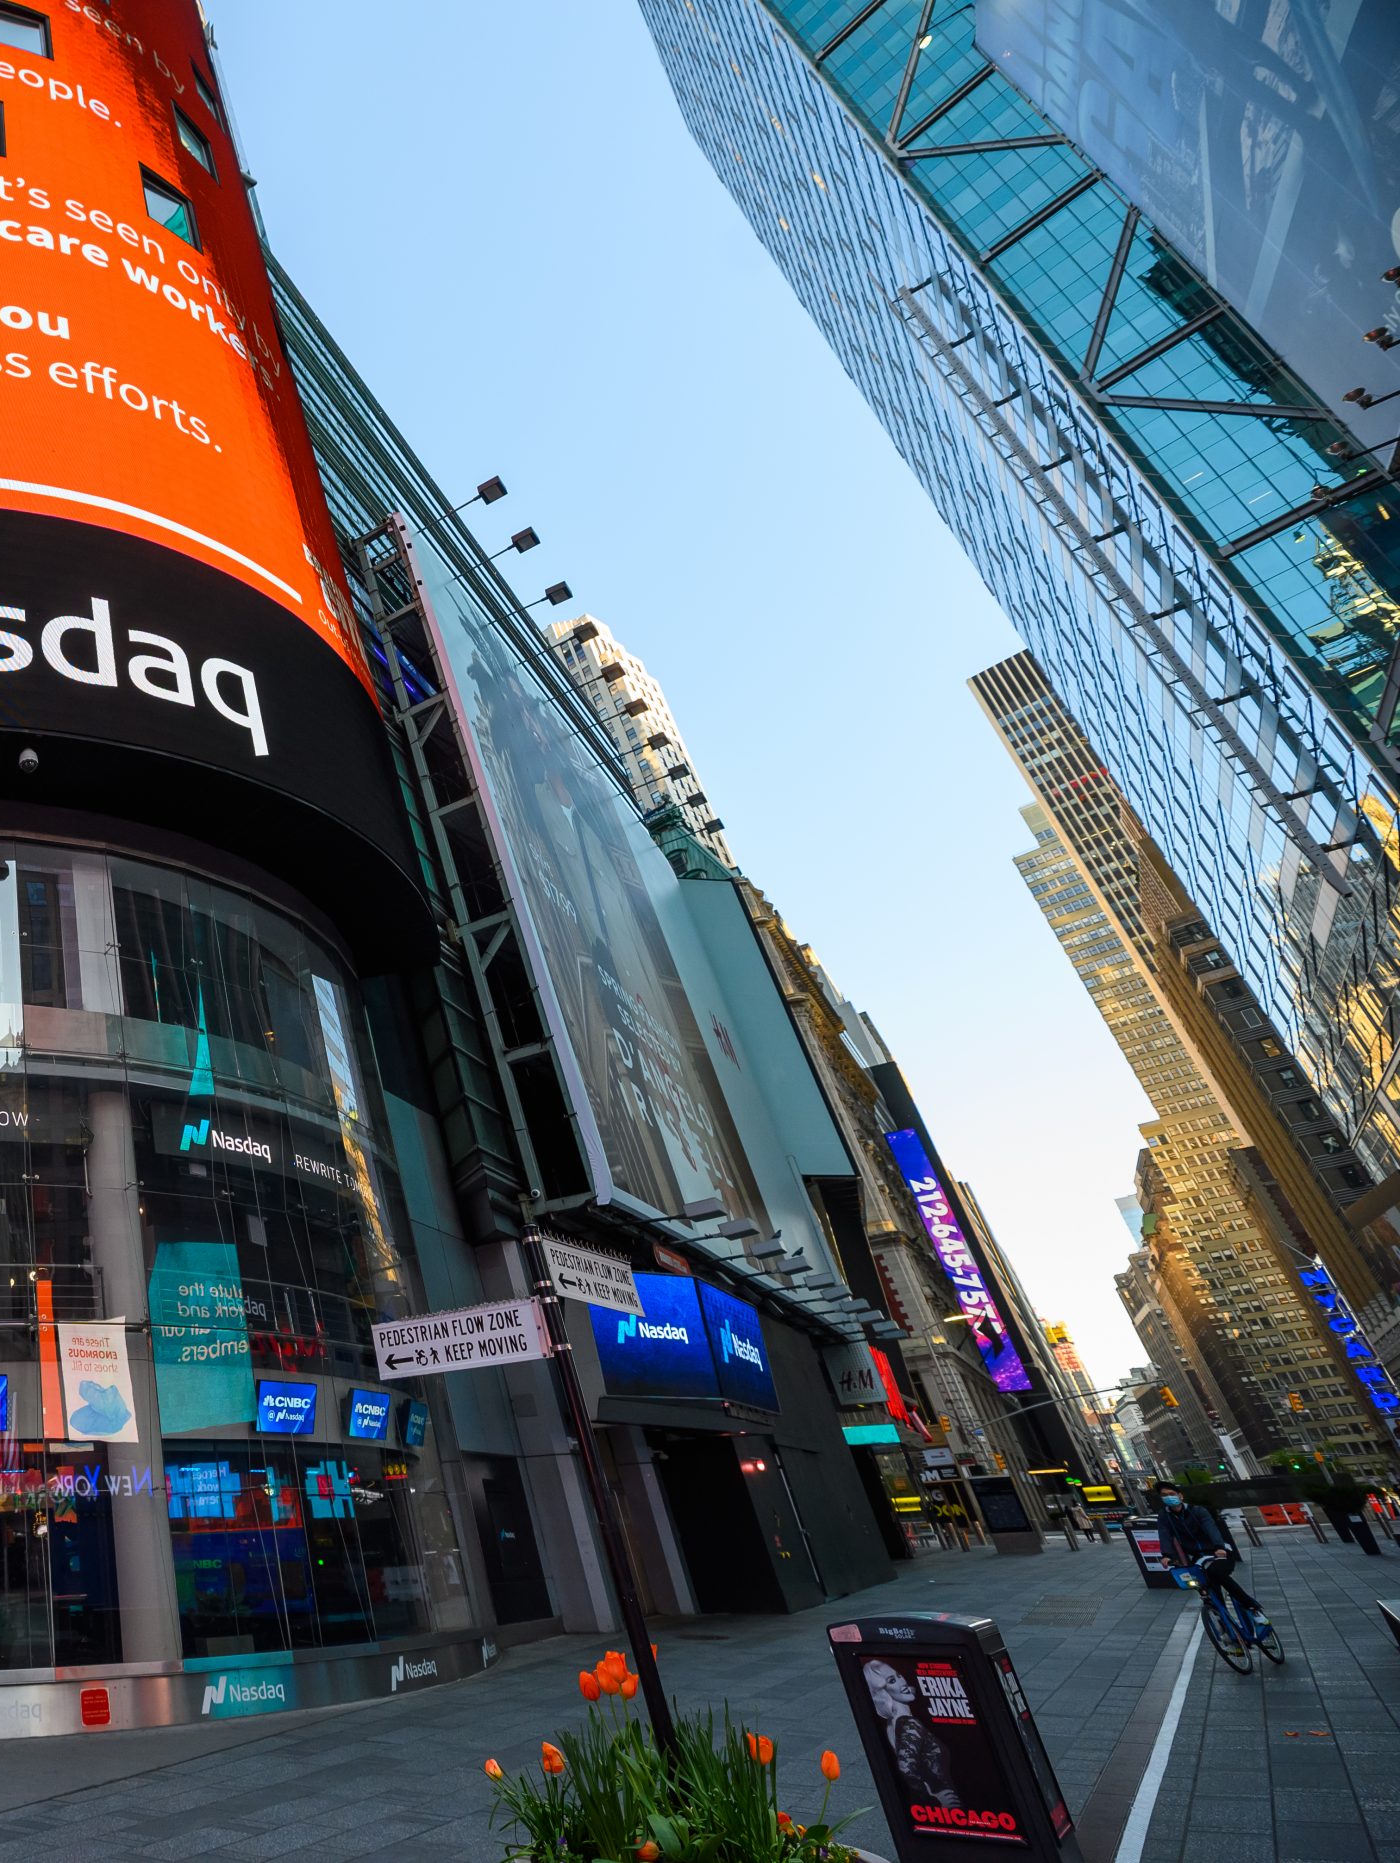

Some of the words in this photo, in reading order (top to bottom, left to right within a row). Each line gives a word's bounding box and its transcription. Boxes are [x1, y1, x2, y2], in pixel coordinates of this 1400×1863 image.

[65, 199, 165, 264] seen
[177, 259, 245, 331] only
[121, 257, 281, 402] workers.
[49, 360, 222, 453] efforts.
[211, 1130, 272, 1164] Nasdaq
[295, 1154, 343, 1185] REWRITE
[551, 1249, 594, 1277] PEDESTRIAN
[594, 1259, 613, 1281] FLOW
[614, 1265, 632, 1287] ZONE
[593, 1280, 611, 1299] KEEP
[612, 1284, 639, 1309] MOVING
[379, 1321, 450, 1348] PEDESTRIAN
[453, 1315, 485, 1336] FLOW
[489, 1308, 523, 1330] ZONE
[638, 1321, 690, 1345] Nasdaq
[444, 1341, 474, 1362] KEEP
[478, 1333, 528, 1358] MOVING
[731, 1332, 764, 1372] Nasdaq
[274, 1396, 311, 1409] CNBC
[285, 1411, 305, 1423] Nasdaq
[405, 1658, 438, 1680] Nasdaq
[229, 1680, 286, 1703] Nasdaq
[916, 1676, 968, 1699] ERIKA
[928, 1698, 975, 1718] JAYNE
[910, 1804, 1017, 1832] CHICAGO
